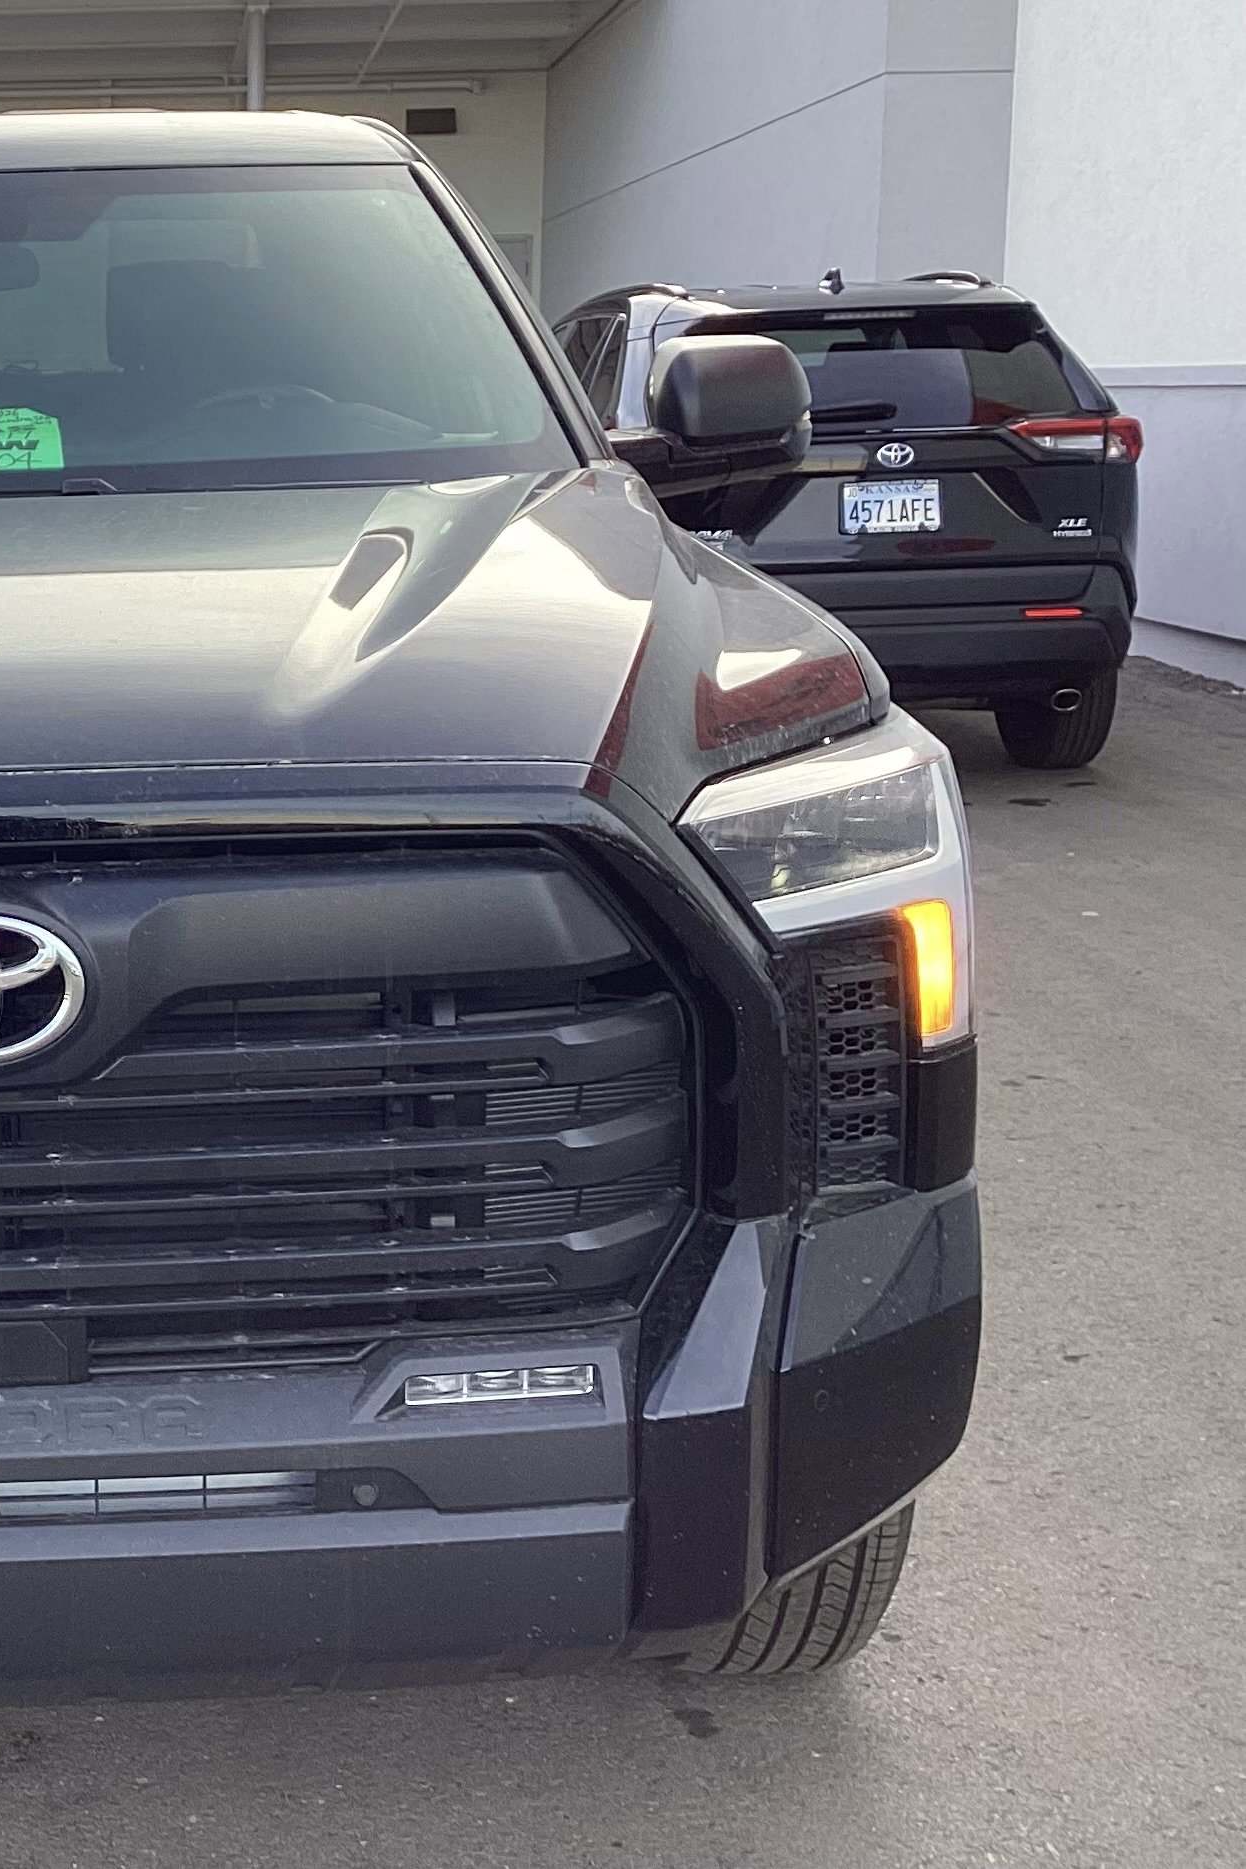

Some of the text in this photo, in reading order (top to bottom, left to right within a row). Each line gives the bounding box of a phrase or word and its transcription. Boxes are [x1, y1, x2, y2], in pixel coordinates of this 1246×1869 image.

[865, 484, 920, 495] KANSAS
[849, 498, 936, 523] 4571AFE
[1058, 517, 1088, 528] XLE
[689, 529, 733, 541] AV4
